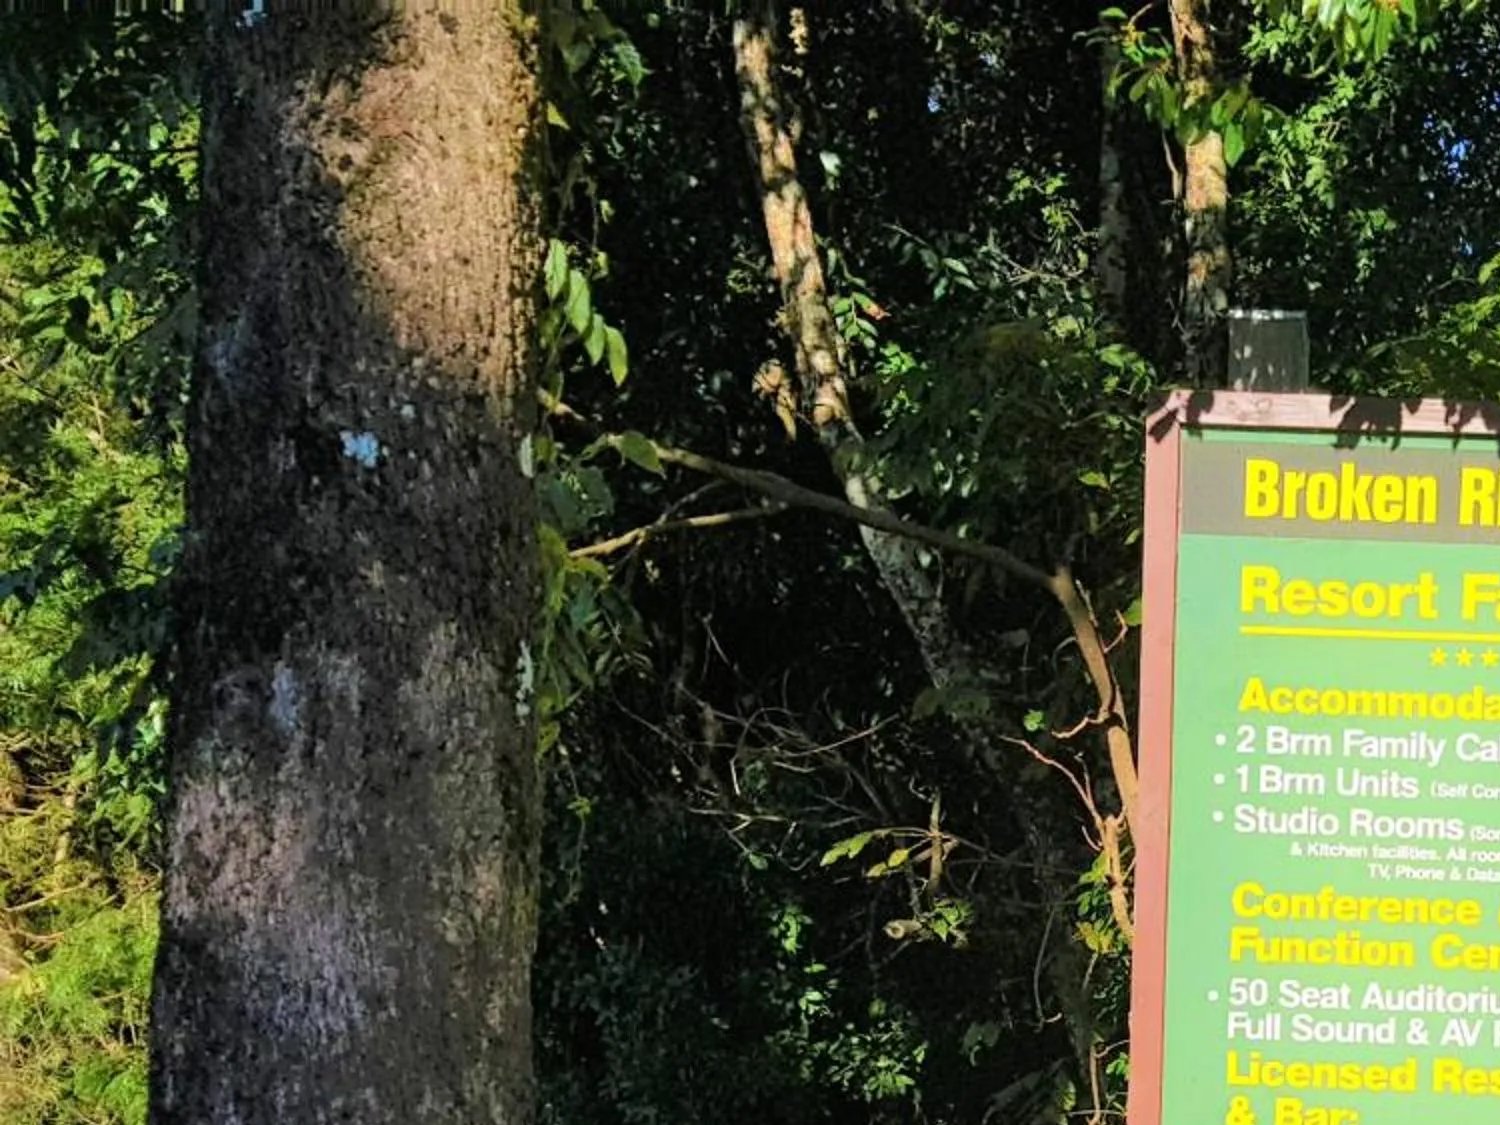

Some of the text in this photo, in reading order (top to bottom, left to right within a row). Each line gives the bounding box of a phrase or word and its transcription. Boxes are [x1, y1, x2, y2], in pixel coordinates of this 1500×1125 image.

[1244, 458, 1437, 525] Broken
[1240, 566, 1439, 620] Resort
[1236, 725, 1256, 753] 2
[1266, 725, 1332, 756] Brm
[1343, 728, 1447, 768] Family
[1236, 764, 1249, 793] 1
[1259, 765, 1325, 794] Brm
[1336, 767, 1420, 799] Units
[1430, 781, 1467, 799] (Self
[1234, 803, 1340, 835] Studio
[1350, 808, 1464, 840] Rooms
[1290, 841, 1302, 856] &
[1307, 842, 1368, 858] Kitchen
[1447, 847, 1466, 862] All
[1395, 865, 1445, 881] Phone
[1449, 867, 1462, 882] &
[1231, 882, 1481, 926] Conference
[1229, 927, 1414, 967] Function
[1228, 978, 1269, 1007] 50
[1279, 980, 1351, 1010] Seat
[1226, 1012, 1281, 1043] Full
[1291, 1014, 1396, 1046] Sound
[1407, 1018, 1428, 1046] &
[1440, 1020, 1481, 1048] AV
[1226, 1050, 1416, 1092] Licensed
